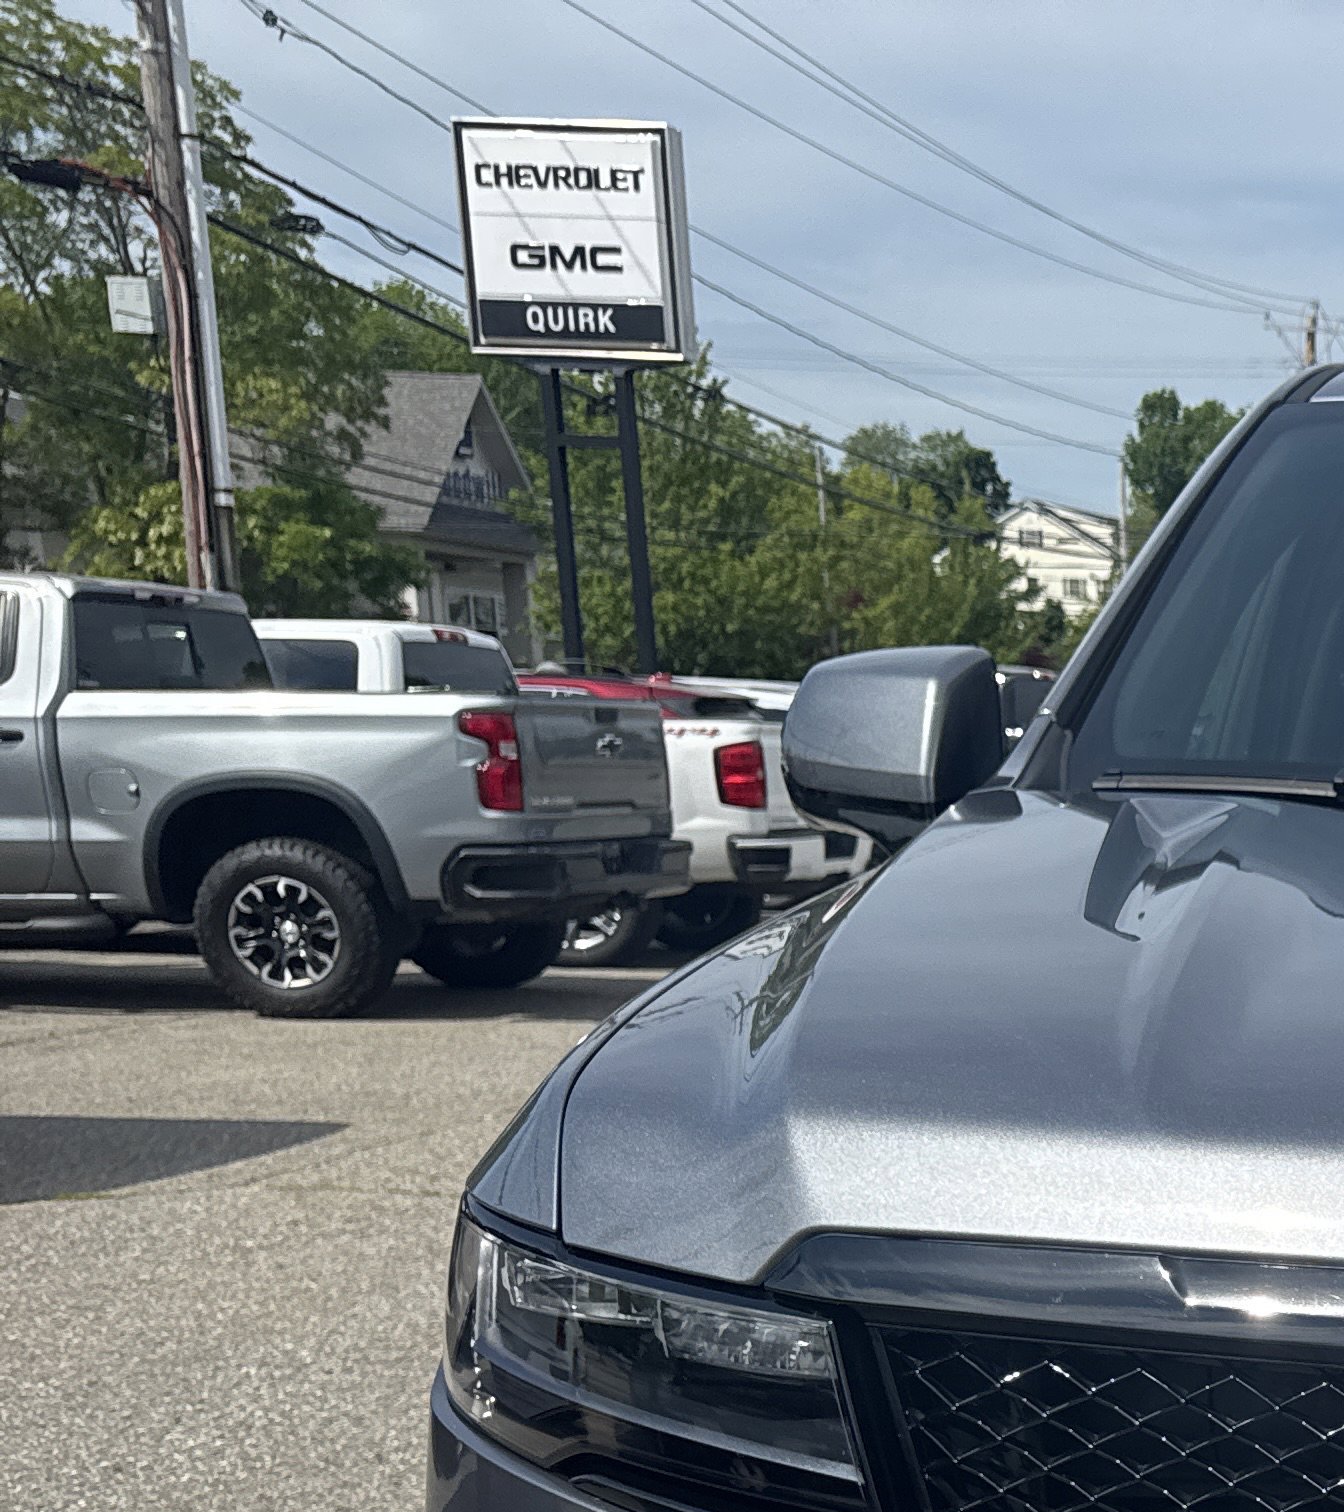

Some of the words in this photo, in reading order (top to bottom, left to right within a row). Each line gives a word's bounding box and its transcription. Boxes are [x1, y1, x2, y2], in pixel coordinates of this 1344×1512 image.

[474, 163, 645, 192] CHEVROLET
[510, 243, 624, 273] GMC
[525, 305, 617, 334] QUIRK
